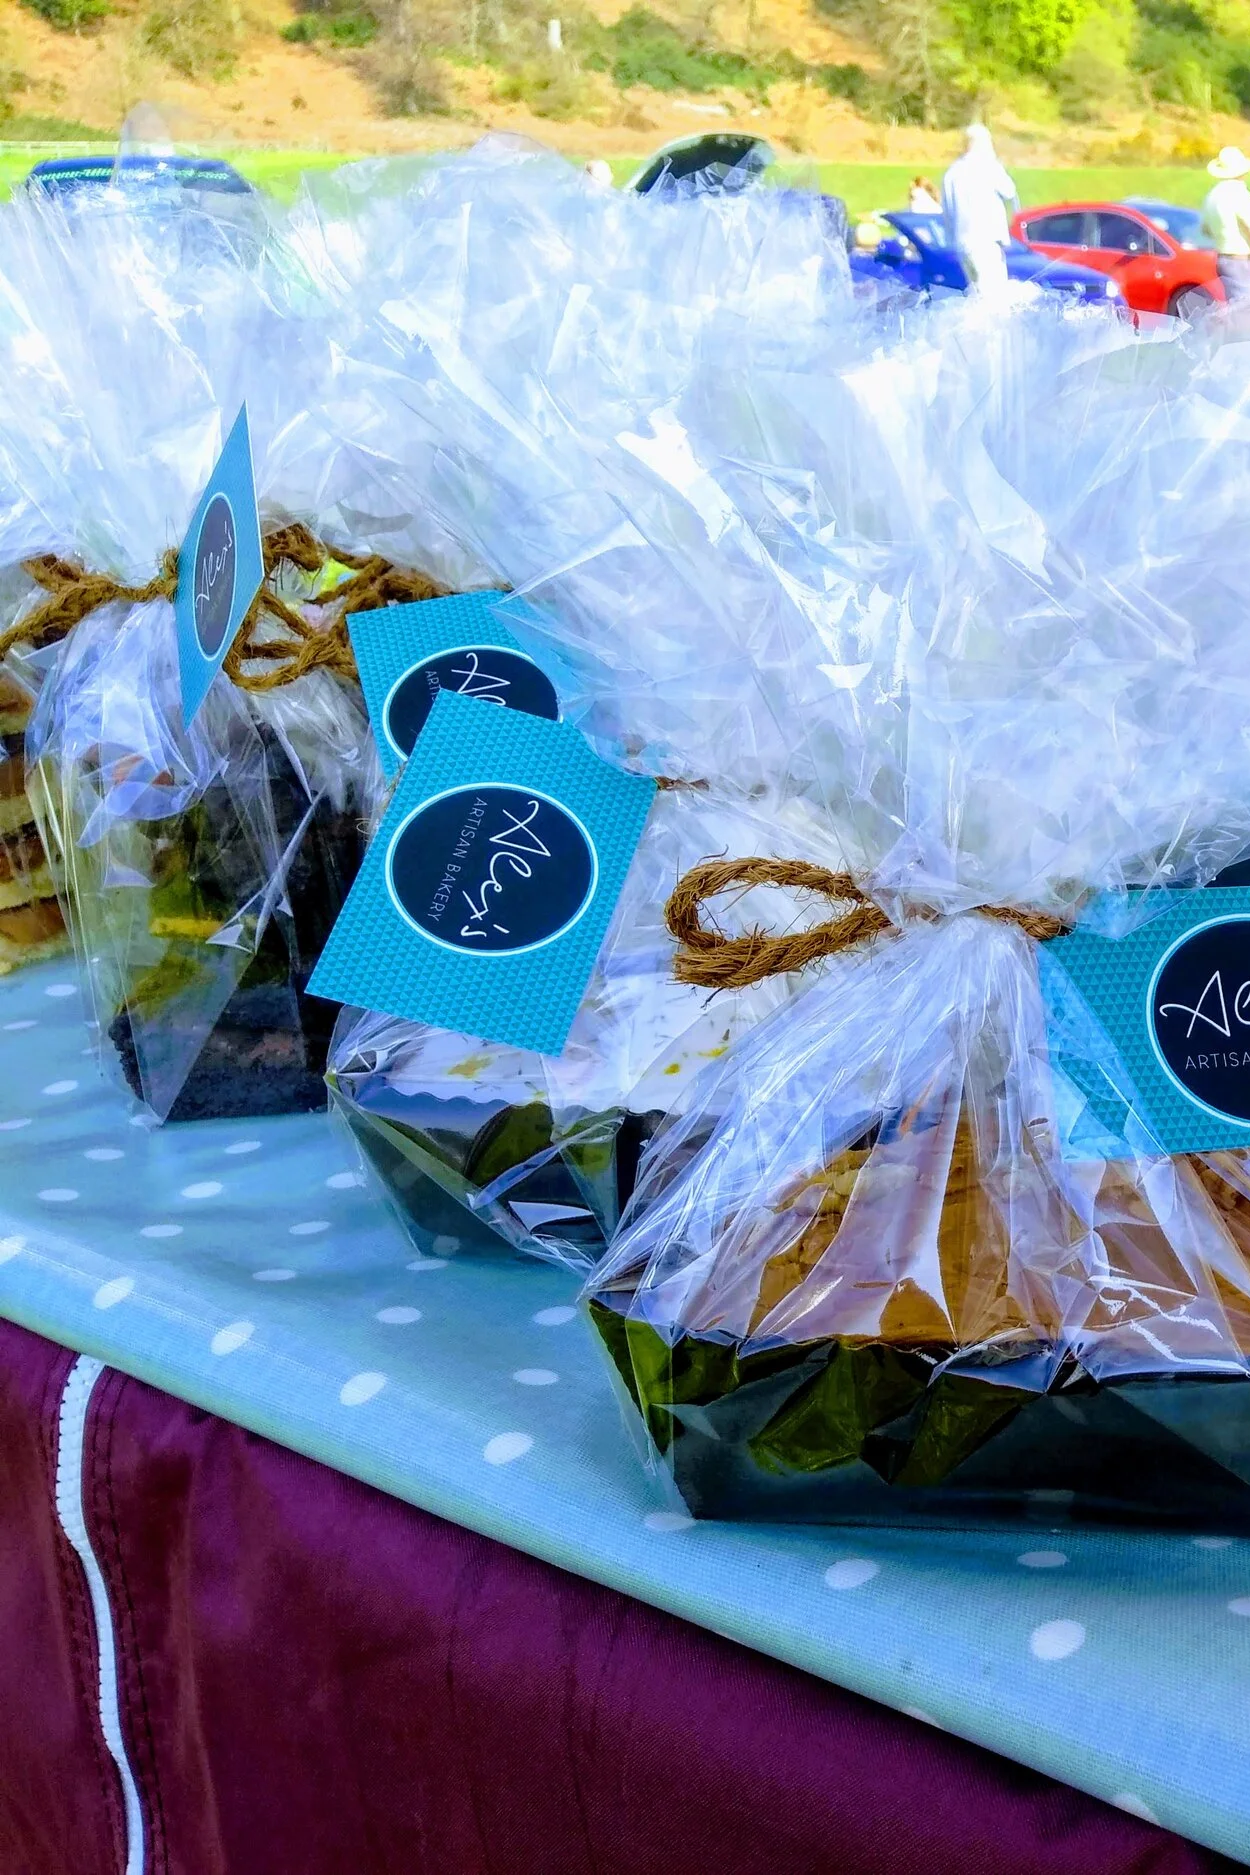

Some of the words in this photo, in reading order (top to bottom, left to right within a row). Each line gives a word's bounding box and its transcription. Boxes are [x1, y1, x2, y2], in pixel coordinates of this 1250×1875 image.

[452, 796, 488, 859] ARTISAN
[427, 863, 461, 922] BAKERY
[460, 800, 551, 937] Alex's
